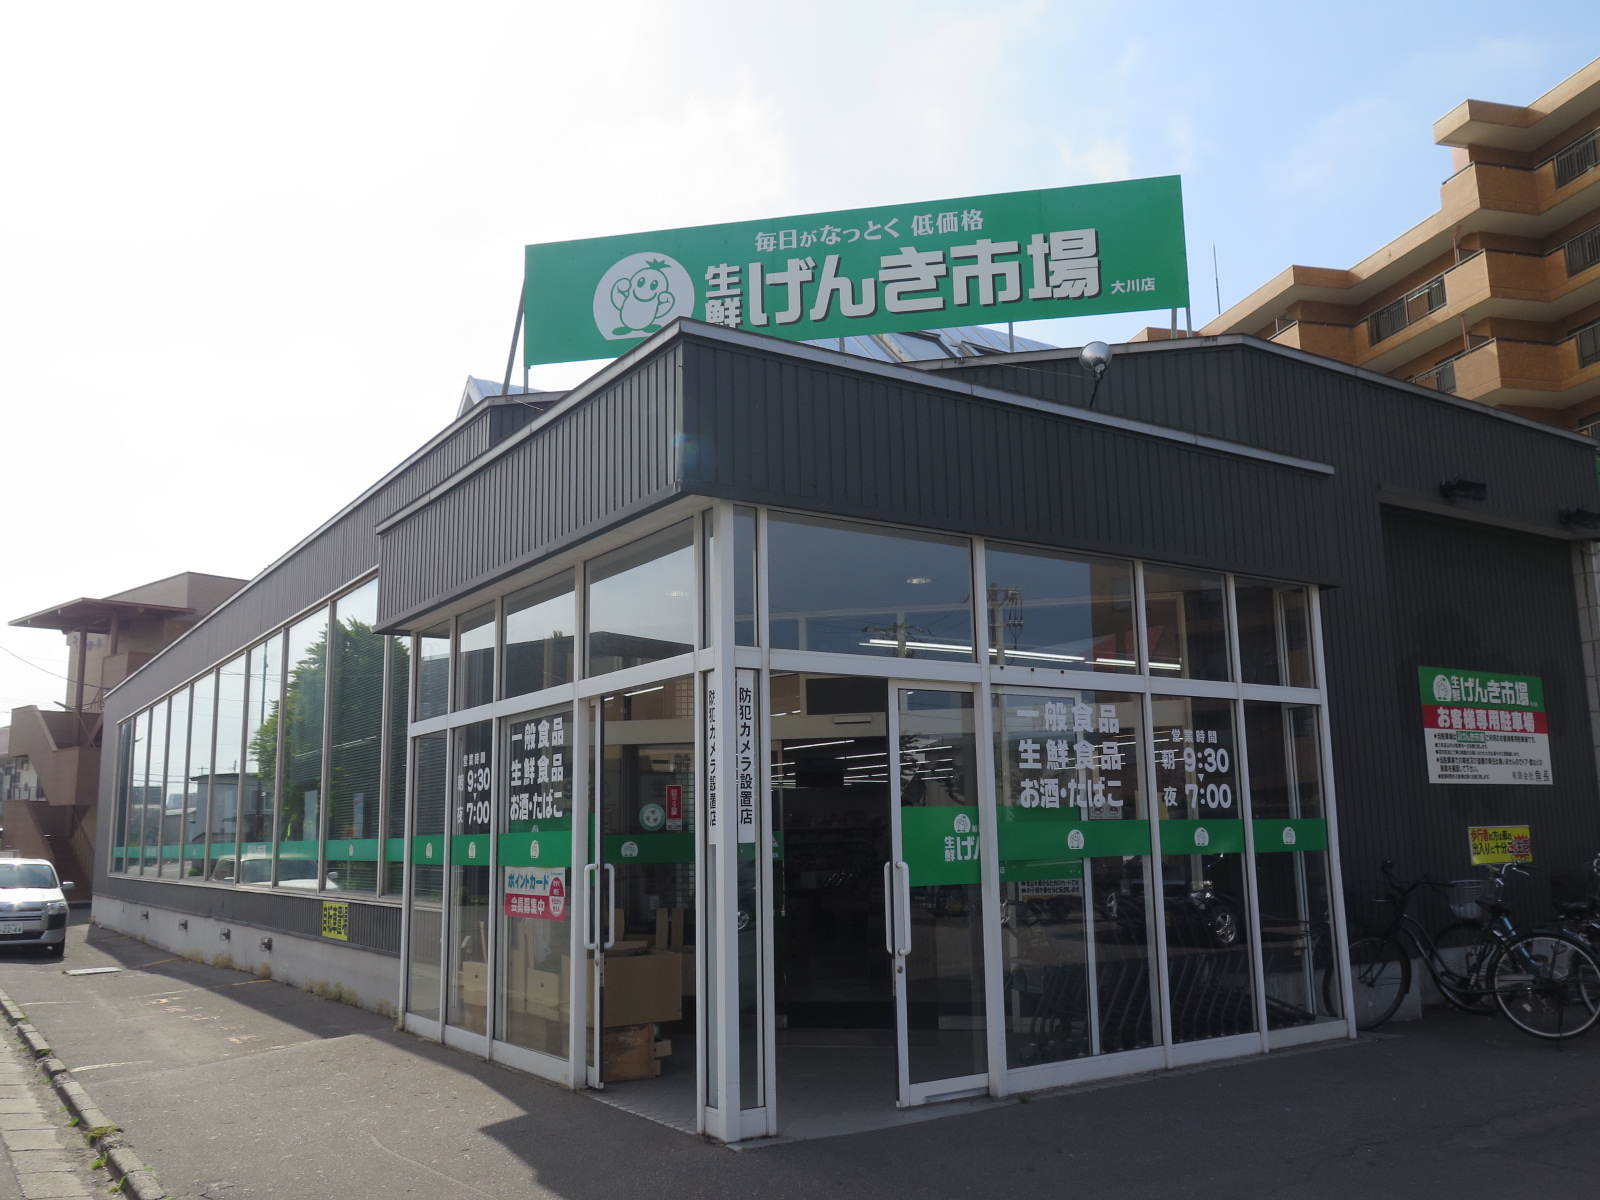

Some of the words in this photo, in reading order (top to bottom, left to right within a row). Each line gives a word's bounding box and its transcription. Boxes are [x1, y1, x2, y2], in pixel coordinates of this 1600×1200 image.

[755, 218, 900, 253] 毎日がなっとく
[911, 209, 985, 237] 低価格
[748, 228, 1100, 326] げんき市場
[1110, 277, 1156, 294] 大川店
[1016, 702, 1120, 734] 一般食品
[511, 716, 564, 751] 一般食品
[1171, 728, 1218, 744] 営業時間
[739, 687, 753, 825] 防犯カメラ設置店
[1017, 740, 1122, 771] 生鮮食品
[1161, 752, 1176, 770] 朝
[1184, 747, 1230, 773] 9:30
[467, 766, 491, 793] 9:30
[510, 753, 564, 788] 生鮮食品
[1163, 786, 1178, 807] 夜
[1185, 783, 1232, 809] 7:00
[466, 800, 490, 825] 7:00
[944, 835, 955, 862] 生鮮
[956, 836, 980, 861] げ
[508, 872, 549, 891] ポイントカード
[511, 896, 545, 915] 会員募集中
